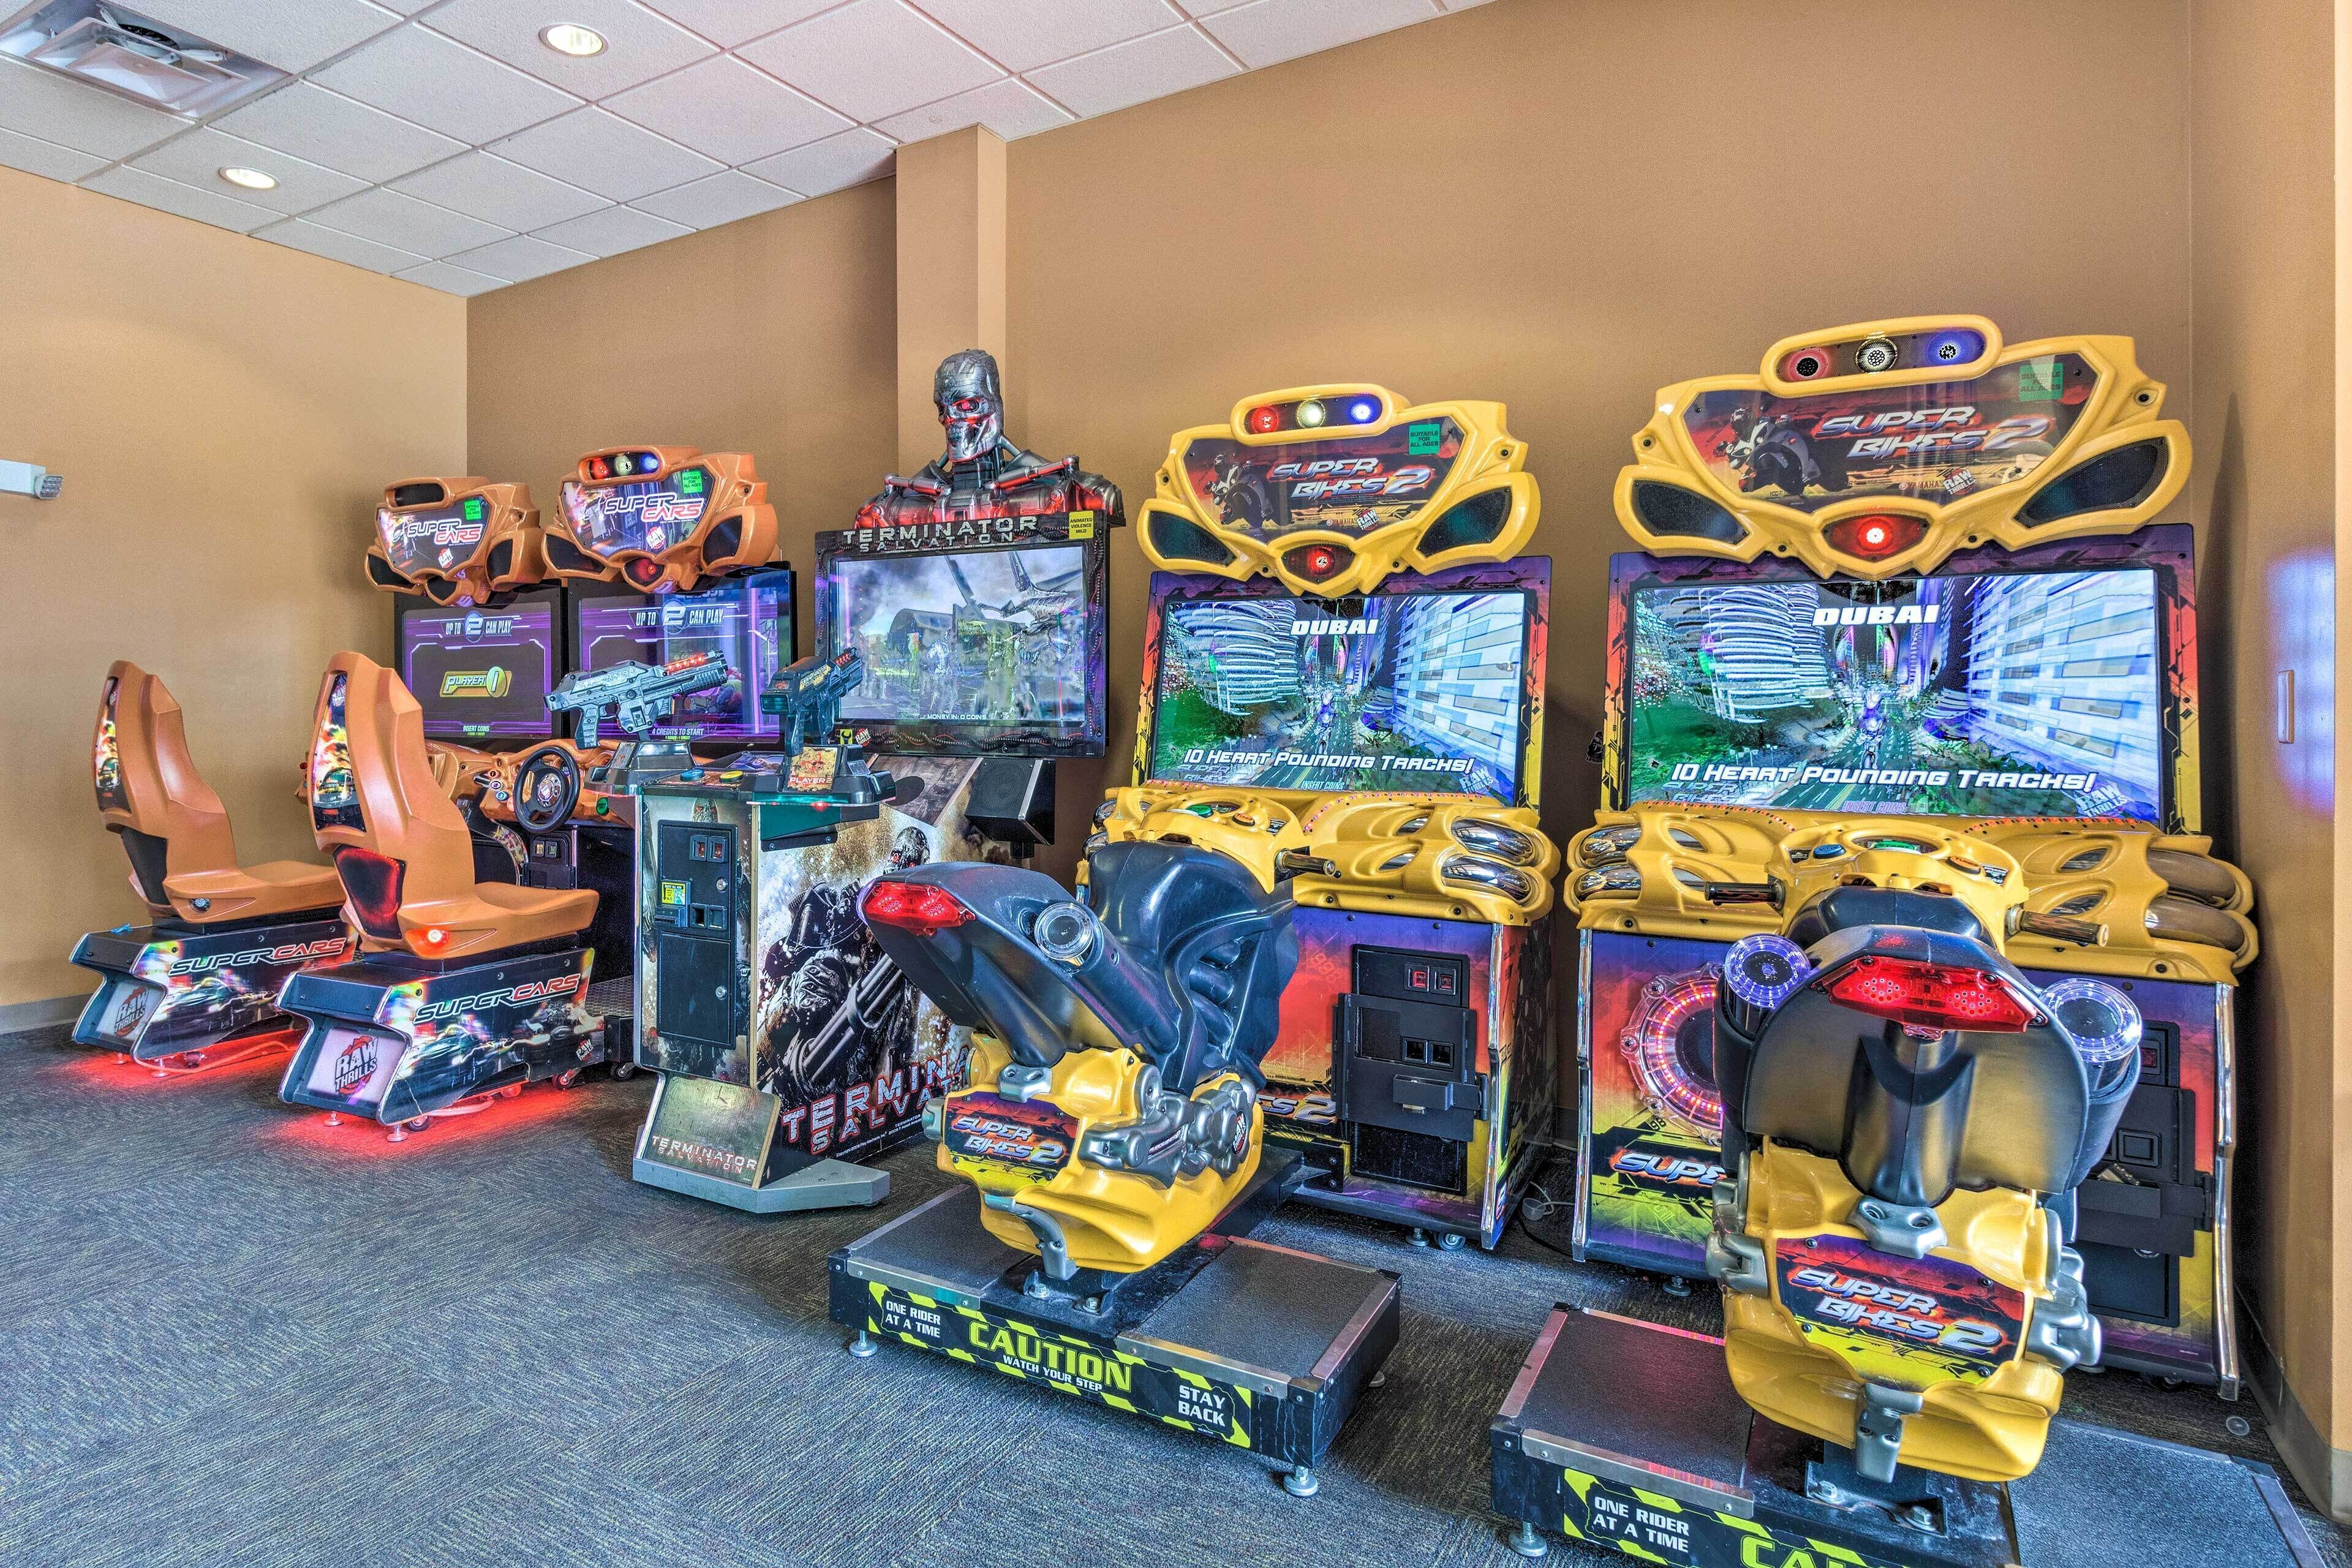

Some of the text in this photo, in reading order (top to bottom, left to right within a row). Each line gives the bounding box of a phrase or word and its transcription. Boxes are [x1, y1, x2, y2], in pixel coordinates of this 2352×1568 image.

[1819, 406, 1976, 435] SUPER
[1846, 417, 2051, 459] BIKES 2
[1270, 458, 1379, 480] SUPER
[1943, 469, 1972, 491] RAW
[1291, 468, 1431, 500] BIKES 2
[1907, 481, 1940, 489] YAMAHA
[1948, 477, 1976, 495] THRILLS
[604, 492, 677, 514] SUPER
[641, 502, 702, 522] CARS
[407, 518, 462, 537] SUPER
[843, 515, 1038, 545] TERMINATOR
[1356, 509, 1377, 527] RAW
[434, 528, 483, 545] CARS
[859, 532, 1014, 552] SALVATION
[445, 617, 512, 636] UP TO 2 CAN PLAY
[636, 606, 724, 627] UP TO 2 CAN PLAY
[1290, 619, 1378, 635] DUBAI
[1813, 605, 1940, 627] DUBAI
[446, 671, 500, 693] PLAYER 1
[855, 728, 869, 741] RAW
[1183, 748, 1476, 774] 10 HEART POUNDING TRACKS!
[1301, 780, 1345, 790] INSERT COINS
[1459, 767, 1490, 788] RAW
[1671, 763, 2099, 793] 10 HEART POUNDING TRACKS!
[1840, 800, 1907, 813] INSERT COINS
[2075, 782, 2122, 810] RAW
[2084, 796, 2129, 817] THRILLS
[167, 937, 347, 977] SUPERCARS
[116, 989, 149, 1023] RAW
[412, 973, 582, 1025] SUPERCARS
[114, 1005, 146, 1035] THRILLS
[335, 1036, 379, 1079] RAW
[576, 1039, 592, 1056] RAW
[334, 1057, 378, 1093] THRILLS
[782, 1045, 968, 1144] TERMINA
[812, 1076, 953, 1155] SALVAT
[953, 1116, 1034, 1142] SUPER
[651, 1135, 758, 1170] TERMINATOR
[657, 1147, 743, 1175] SALVATION
[963, 1134, 1065, 1165] BIKES 2
[1613, 1152, 1725, 1186] SUPE
[1790, 1267, 1939, 1315] SUPER
[884, 1313, 940, 1338] AT A TIME
[886, 1300, 941, 1325] ONE RIDER
[1814, 1297, 2003, 1354] BIKES 2
[968, 1320, 1132, 1393] CAUTION
[1003, 1354, 1103, 1392] WATCH YOUR STEP
[1178, 1384, 1226, 1409] STAY
[1178, 1400, 1226, 1427] BACK
[1594, 1496, 1689, 1537] ONE RIDER
[1593, 1513, 1689, 1553] AT A TIME
